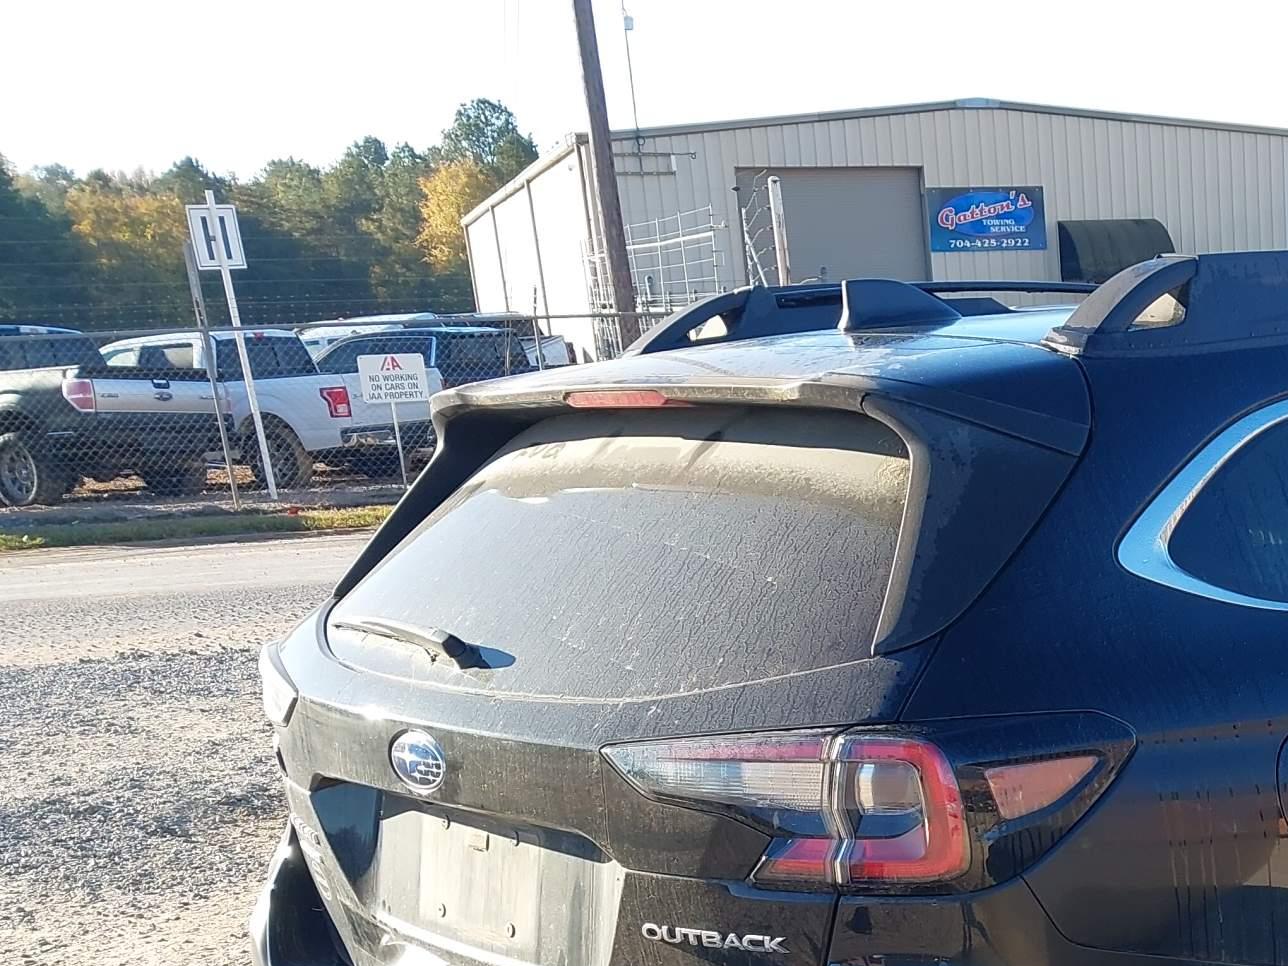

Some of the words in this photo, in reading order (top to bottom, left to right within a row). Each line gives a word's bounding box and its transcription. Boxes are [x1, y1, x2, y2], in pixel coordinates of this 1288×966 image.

[938, 191, 1032, 229] Gatton's
[949, 238, 1030, 248] 704-425-2922
[382, 373, 418, 382] WORKING
[371, 383, 382, 391] ON
[385, 383, 405, 391] CARS
[407, 382, 419, 390] ON
[369, 392, 382, 400] IAA
[385, 391, 423, 399] PROPERTY
[641, 922, 791, 954] OUTBACK
